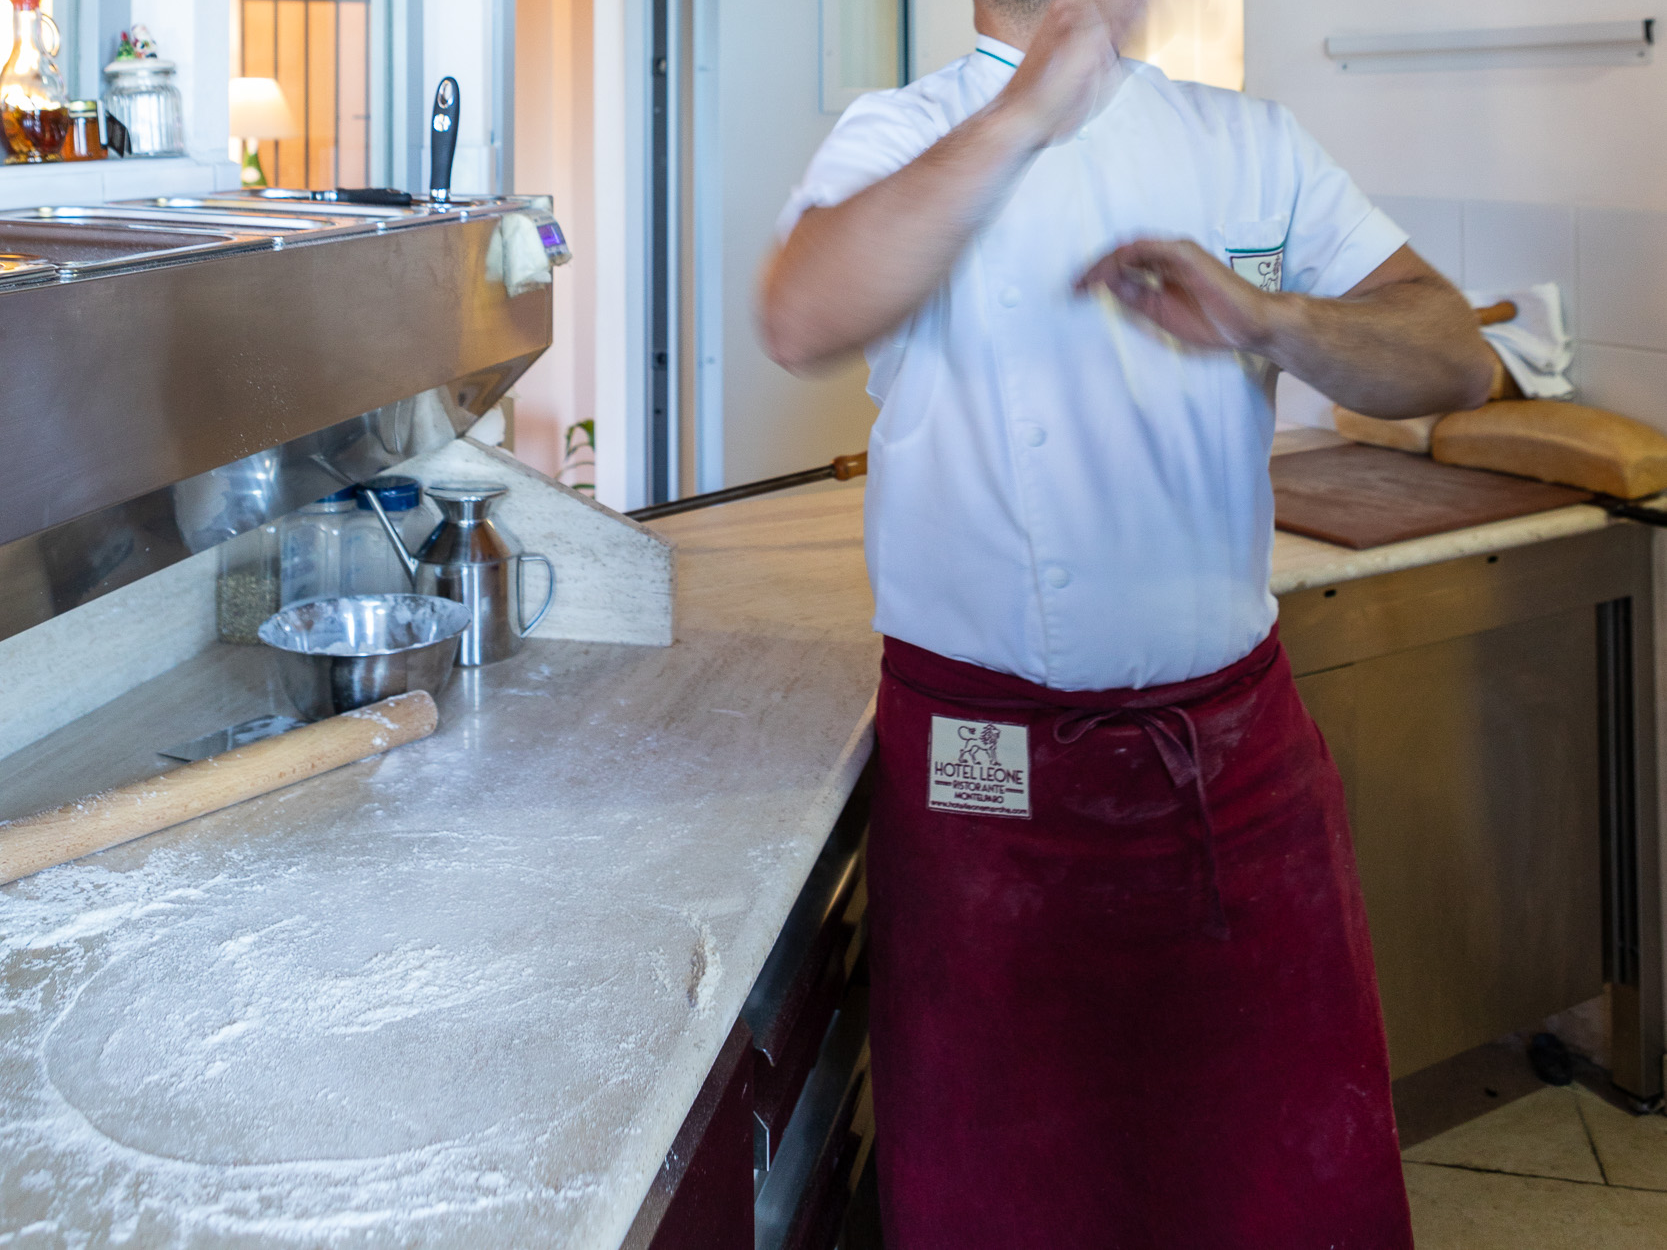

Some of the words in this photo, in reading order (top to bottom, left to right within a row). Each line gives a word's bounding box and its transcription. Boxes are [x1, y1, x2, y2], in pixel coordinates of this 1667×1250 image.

[935, 761, 976, 780] HOTEL
[980, 766, 1024, 785] LEONE
[953, 780, 1005, 794] RISTORANTE
